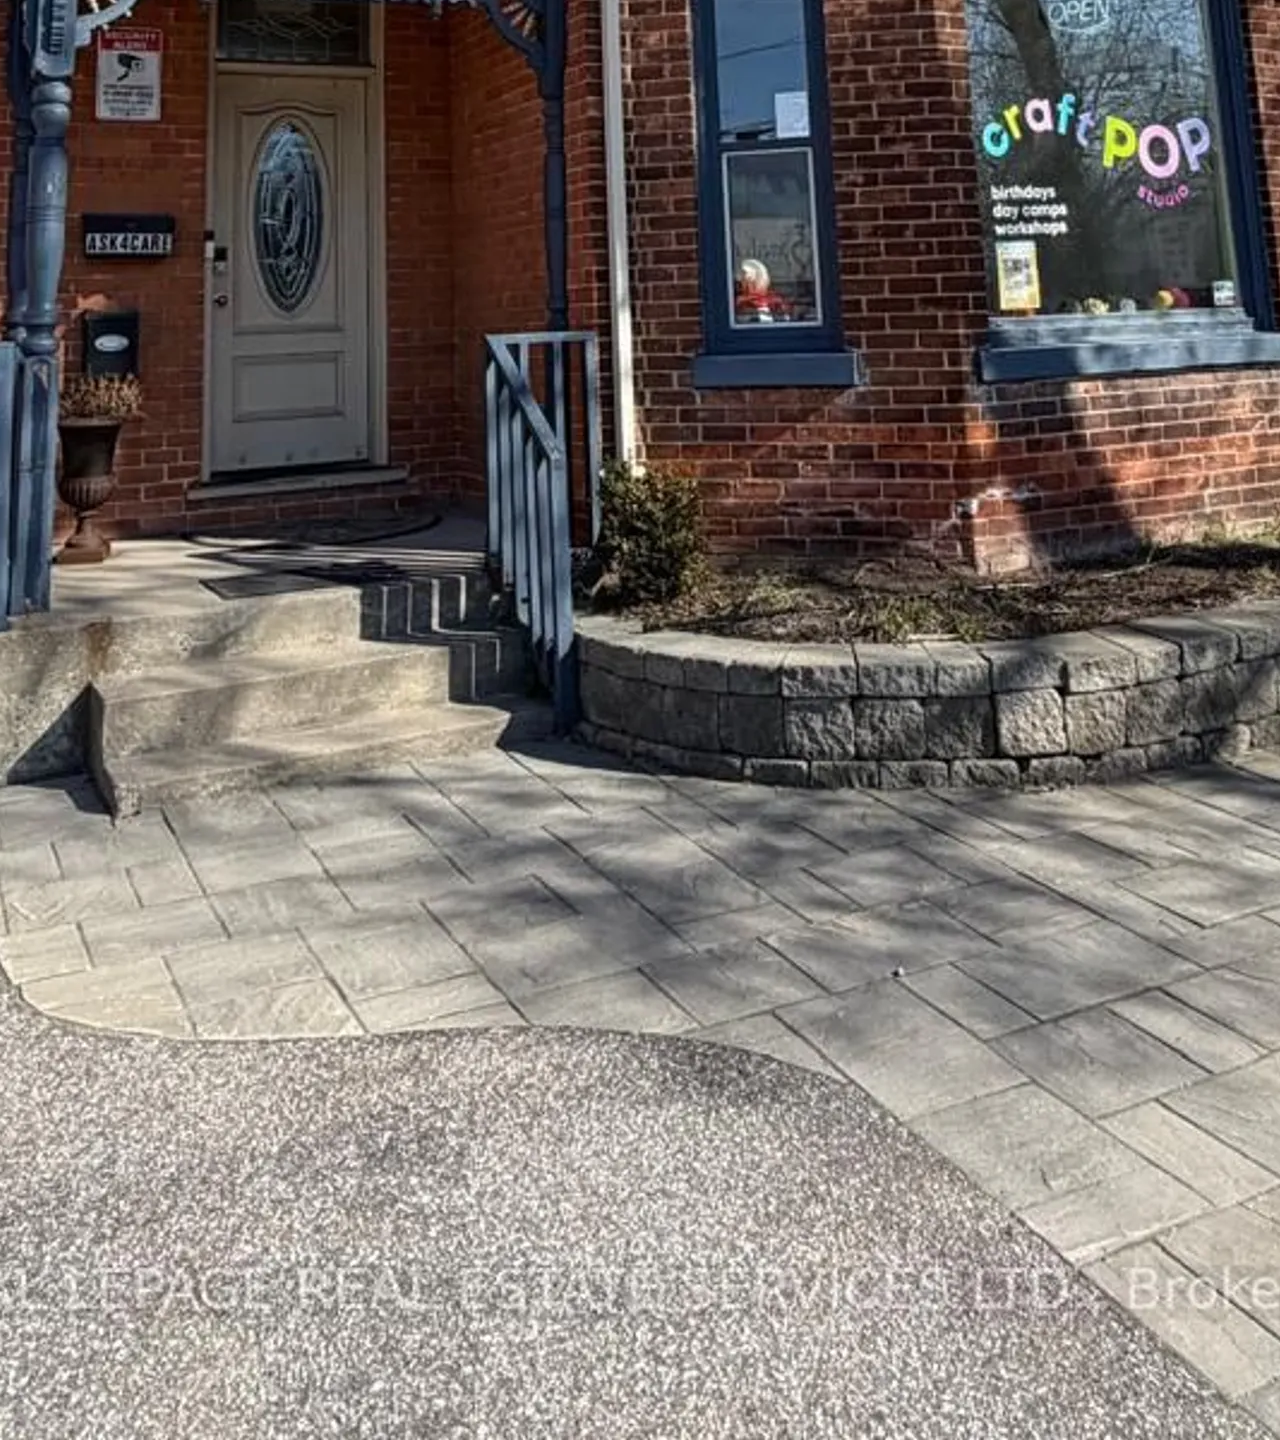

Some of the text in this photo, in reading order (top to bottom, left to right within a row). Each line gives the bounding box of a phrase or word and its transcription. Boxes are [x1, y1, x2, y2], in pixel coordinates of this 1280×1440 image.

[1048, 0, 1109, 22] OPEN
[982, 93, 1211, 178] craft POP
[990, 184, 1056, 201] birthdays
[992, 203, 1068, 220] day camps
[994, 220, 1068, 237] workshops
